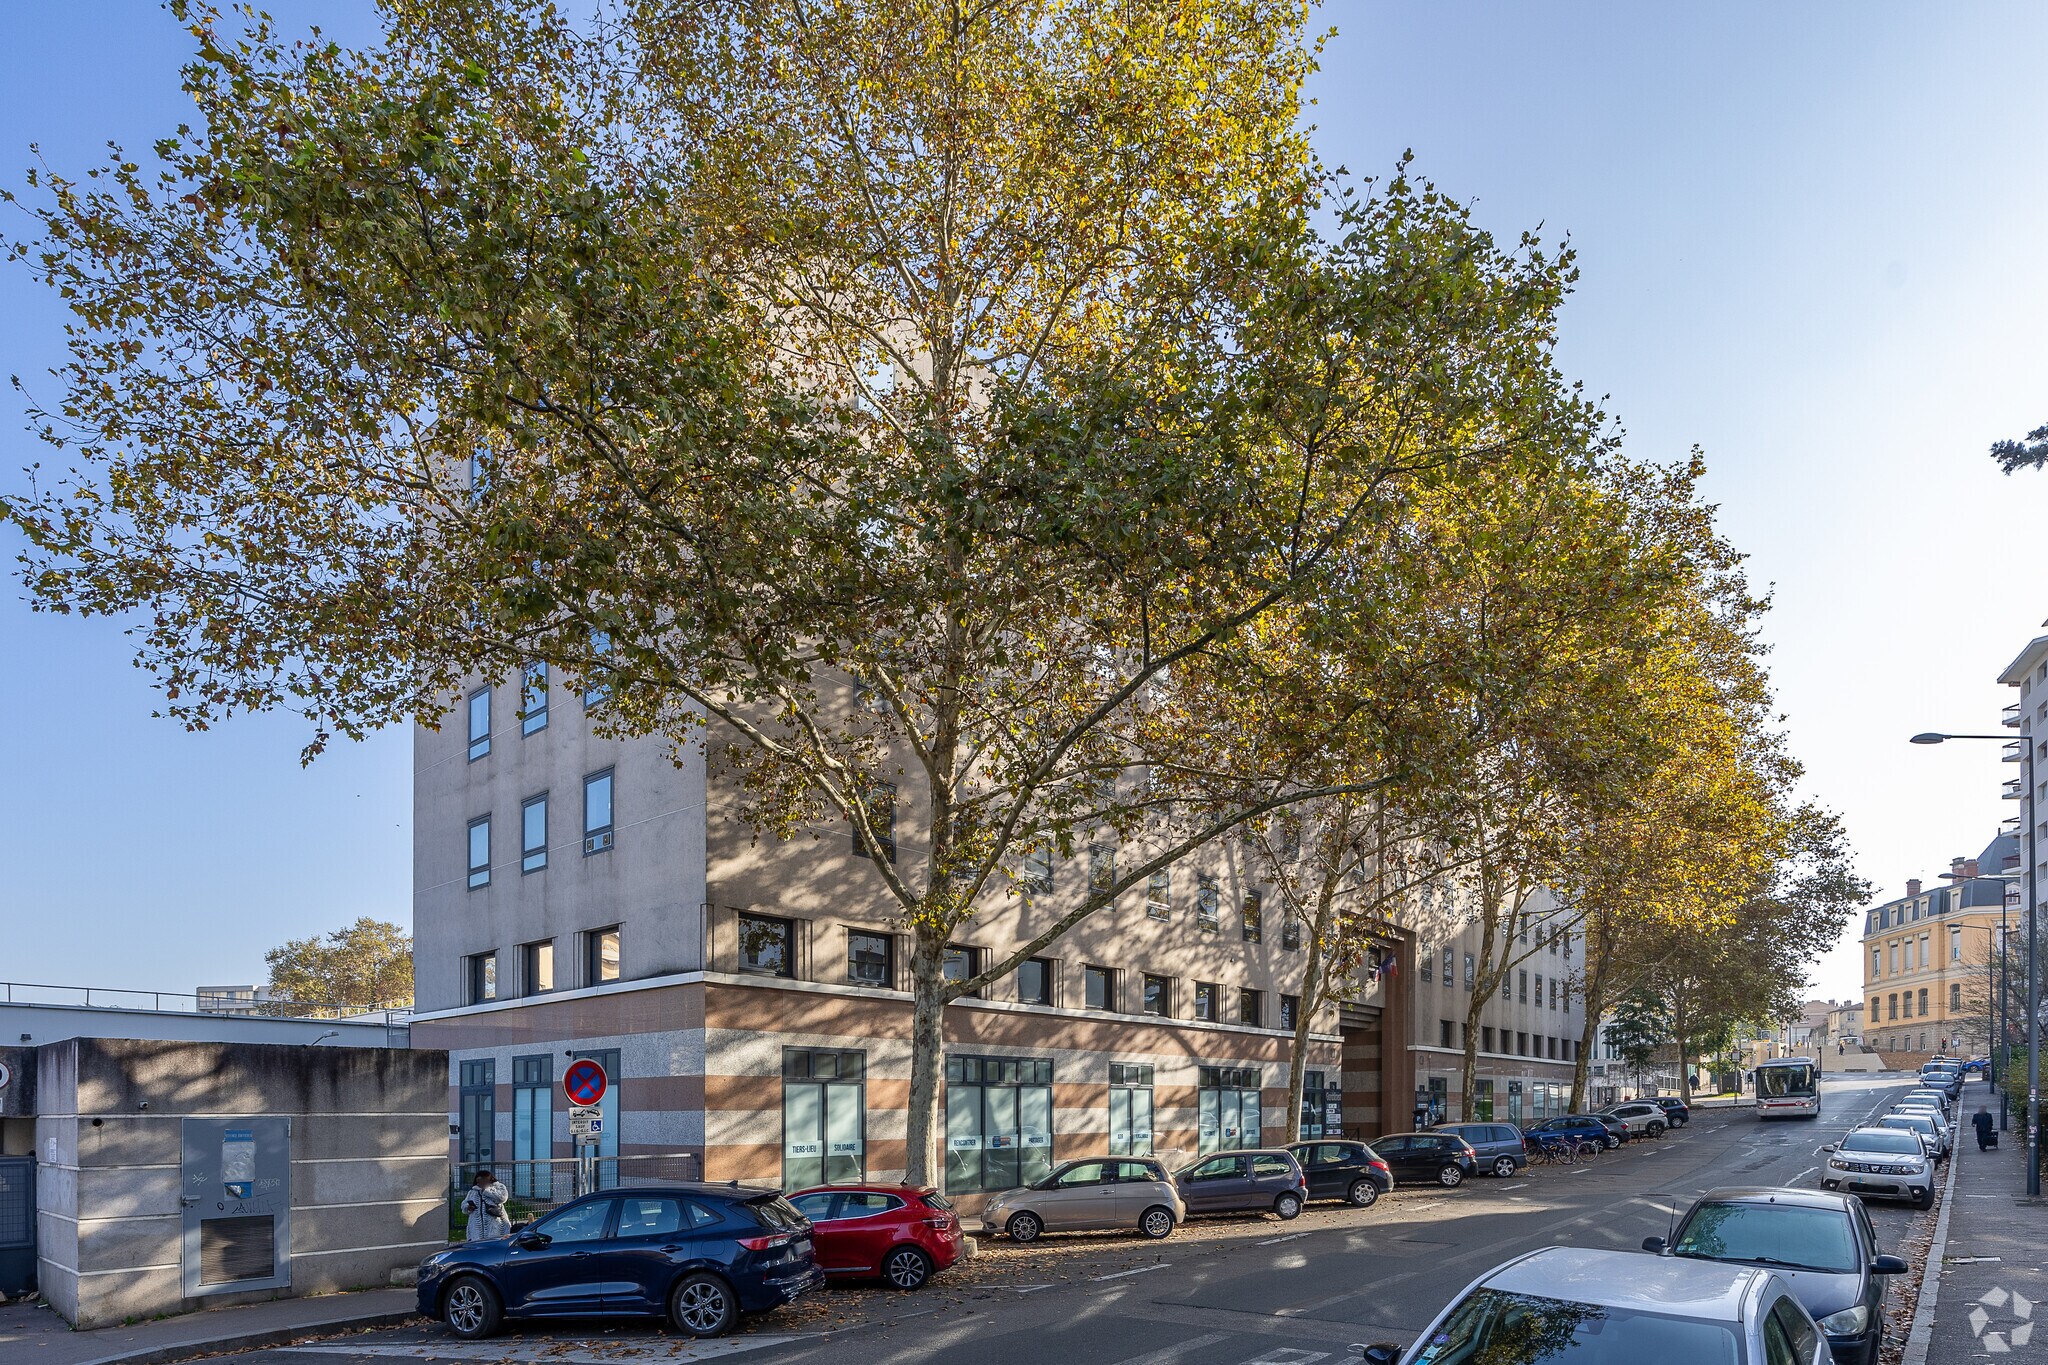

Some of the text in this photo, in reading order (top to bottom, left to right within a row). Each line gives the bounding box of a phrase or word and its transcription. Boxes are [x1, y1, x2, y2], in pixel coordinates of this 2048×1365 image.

[953, 1139, 976, 1147] RENCONTRER
[792, 1143, 856, 1154] TIERS-LIEU SOLIDAIRE
